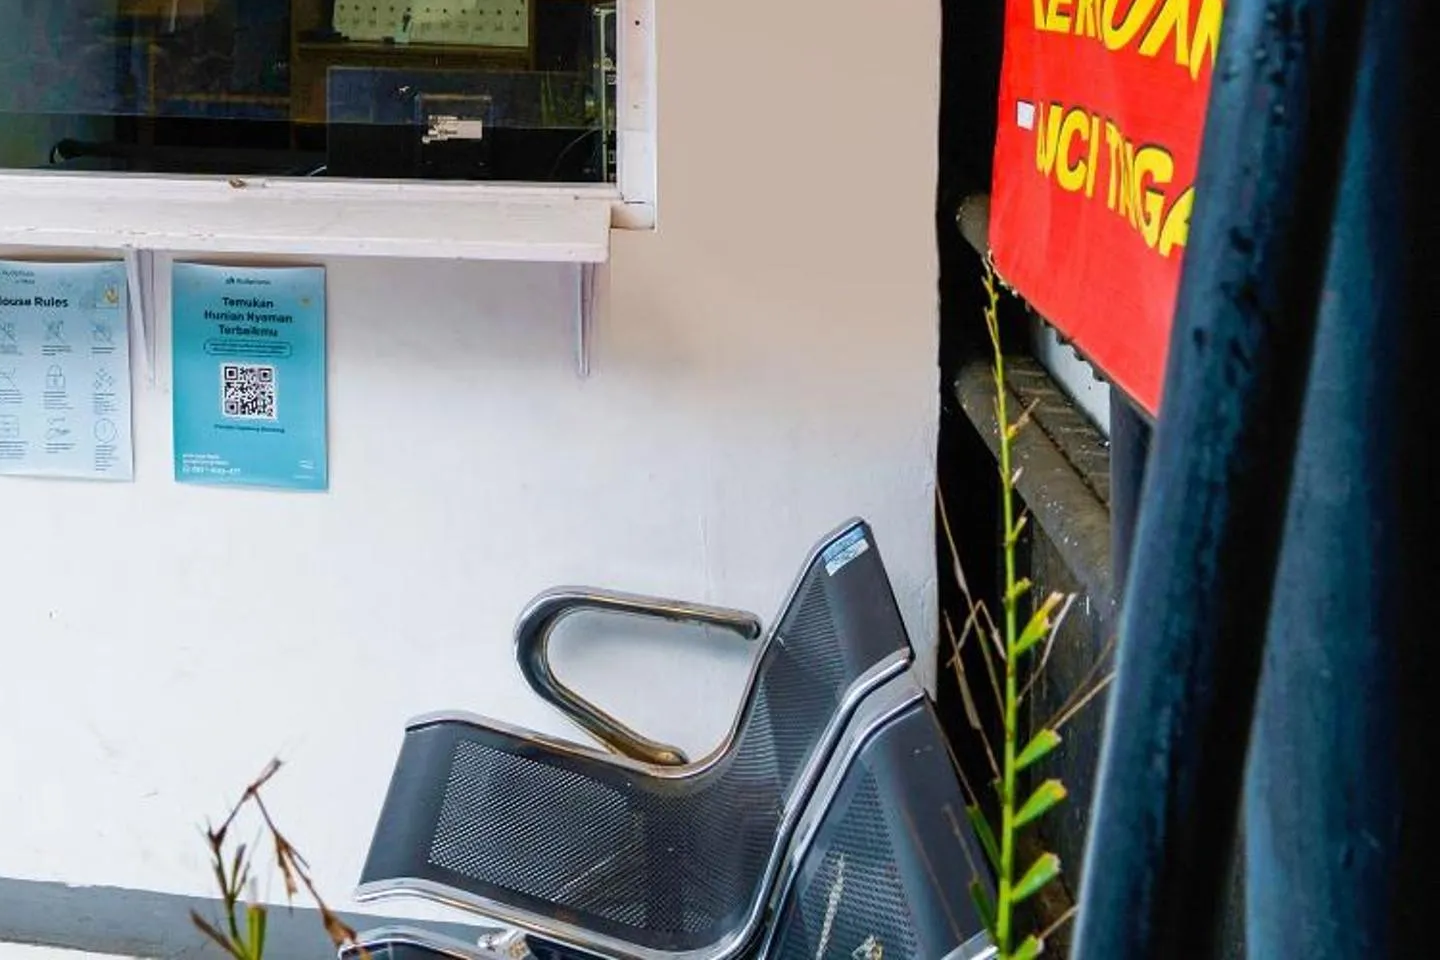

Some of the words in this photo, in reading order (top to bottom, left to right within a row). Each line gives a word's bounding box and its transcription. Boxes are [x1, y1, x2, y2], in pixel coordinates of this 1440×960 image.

[34, 297, 69, 308] Rules
[222, 296, 274, 309] Temukan
[204, 309, 244, 320] Hunian
[247, 310, 293, 324] Nyaman
[219, 324, 278, 338] Terbaikmu
